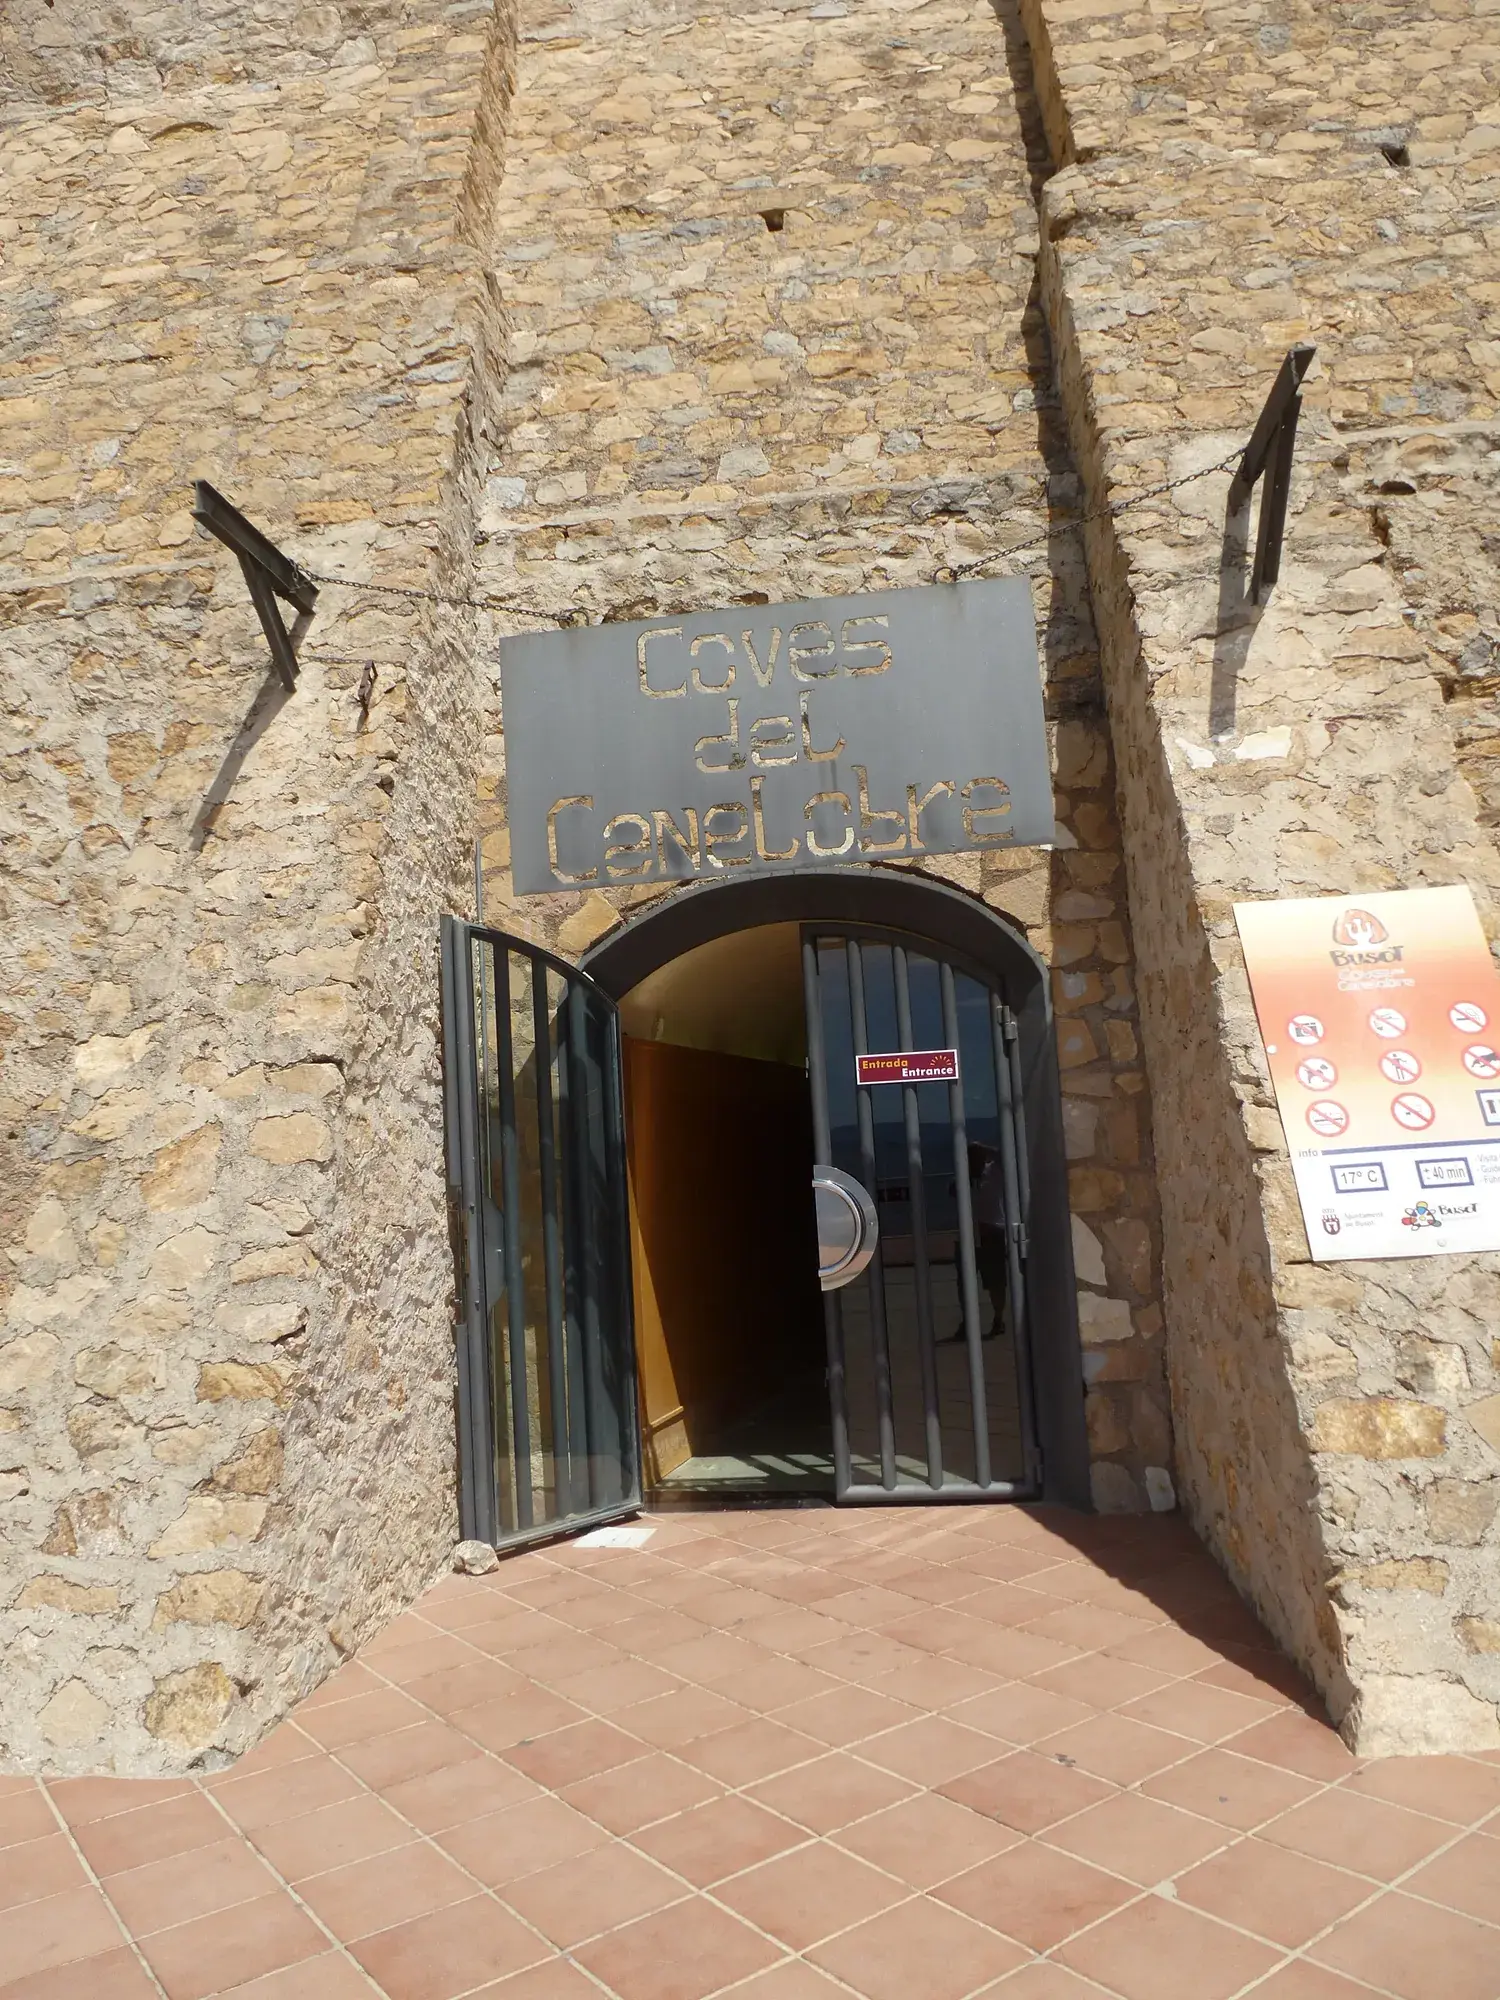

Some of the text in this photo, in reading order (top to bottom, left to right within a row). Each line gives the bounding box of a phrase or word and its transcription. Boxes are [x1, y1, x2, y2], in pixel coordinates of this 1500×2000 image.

[636, 614, 893, 698] Coves
[862, 1058, 908, 1069] Entrada
[902, 1067, 953, 1077] Entrance
[1299, 1149, 1318, 1157] info
[1433, 1166, 1444, 1179] 40
[1446, 1168, 1466, 1179] min
